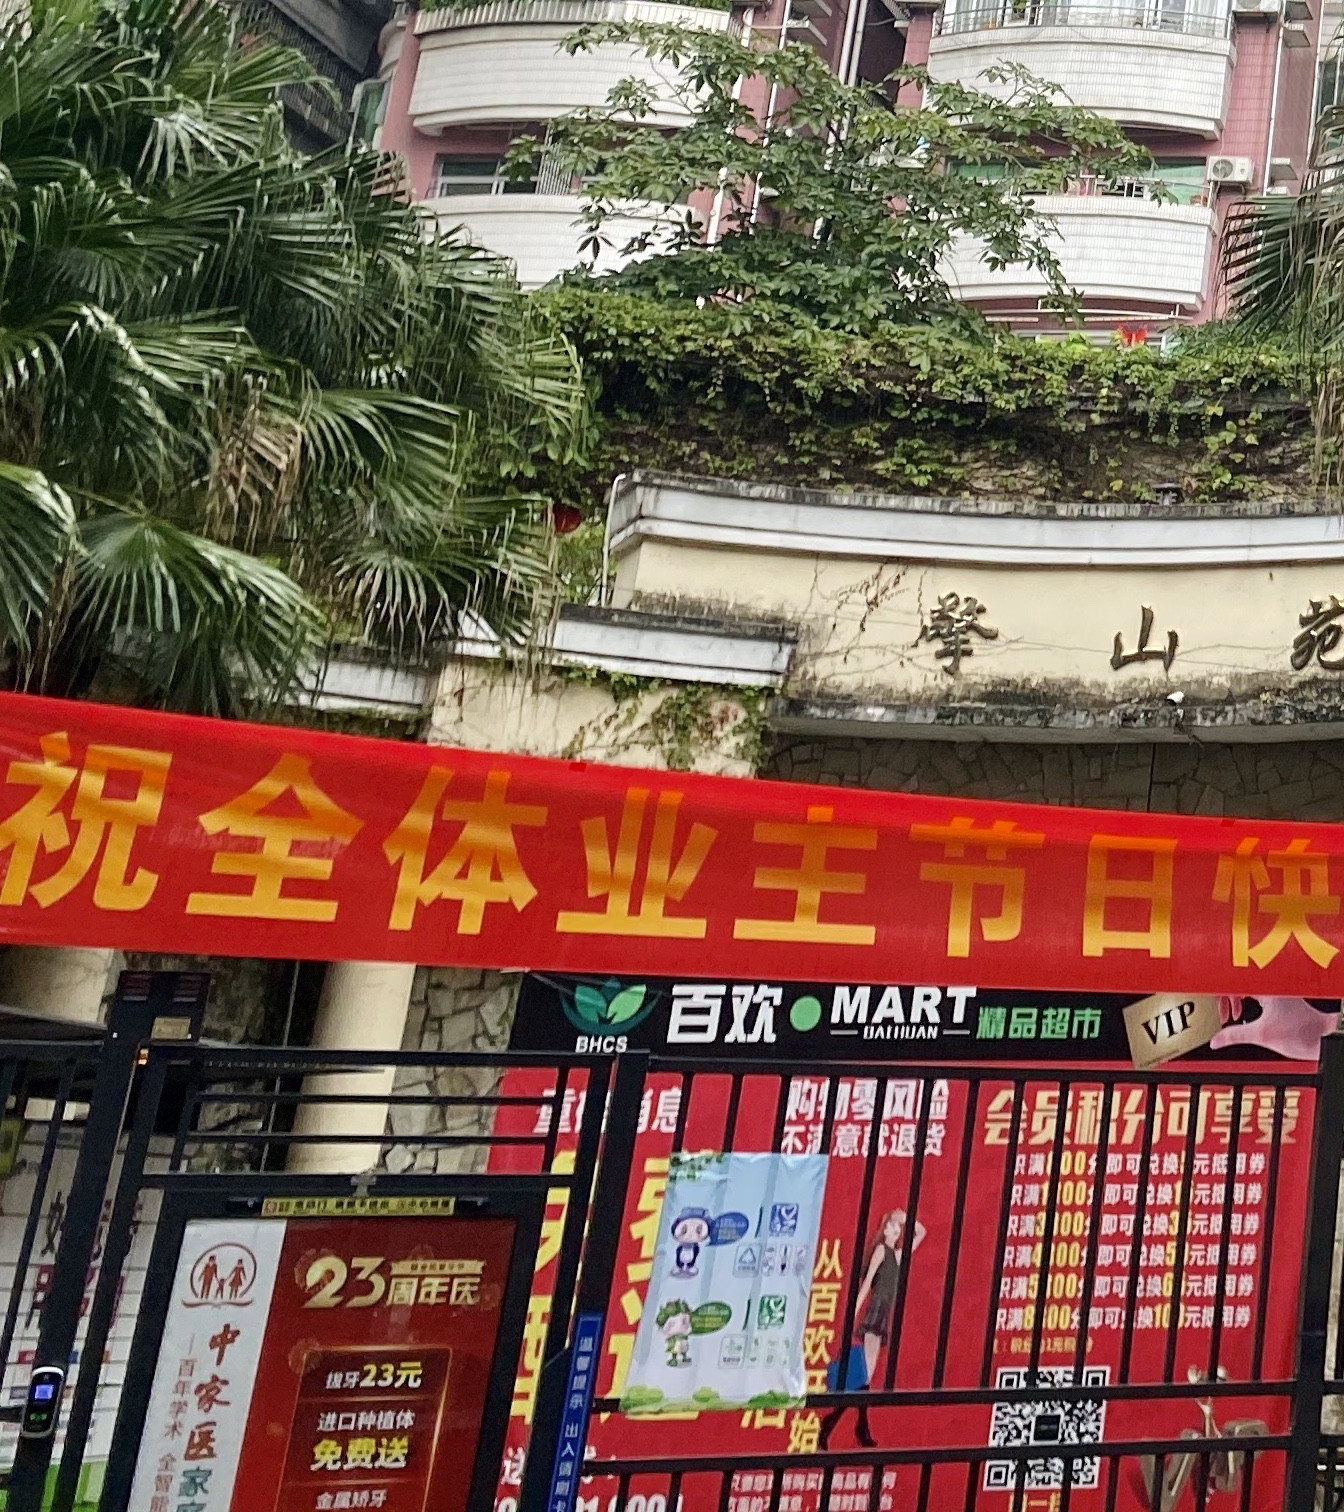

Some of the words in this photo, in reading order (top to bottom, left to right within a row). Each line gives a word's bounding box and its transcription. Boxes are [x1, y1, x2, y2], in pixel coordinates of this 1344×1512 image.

[667, 984, 783, 1044] 百欢
[830, 985, 978, 1024] MART
[976, 1005, 1102, 1041] 精品超市
[1140, 1000, 1197, 1046] VIP
[575, 1035, 628, 1054] BHCS
[317, 1409, 416, 1433] 进口种植体
[310, 1435, 410, 1471] 免费送
